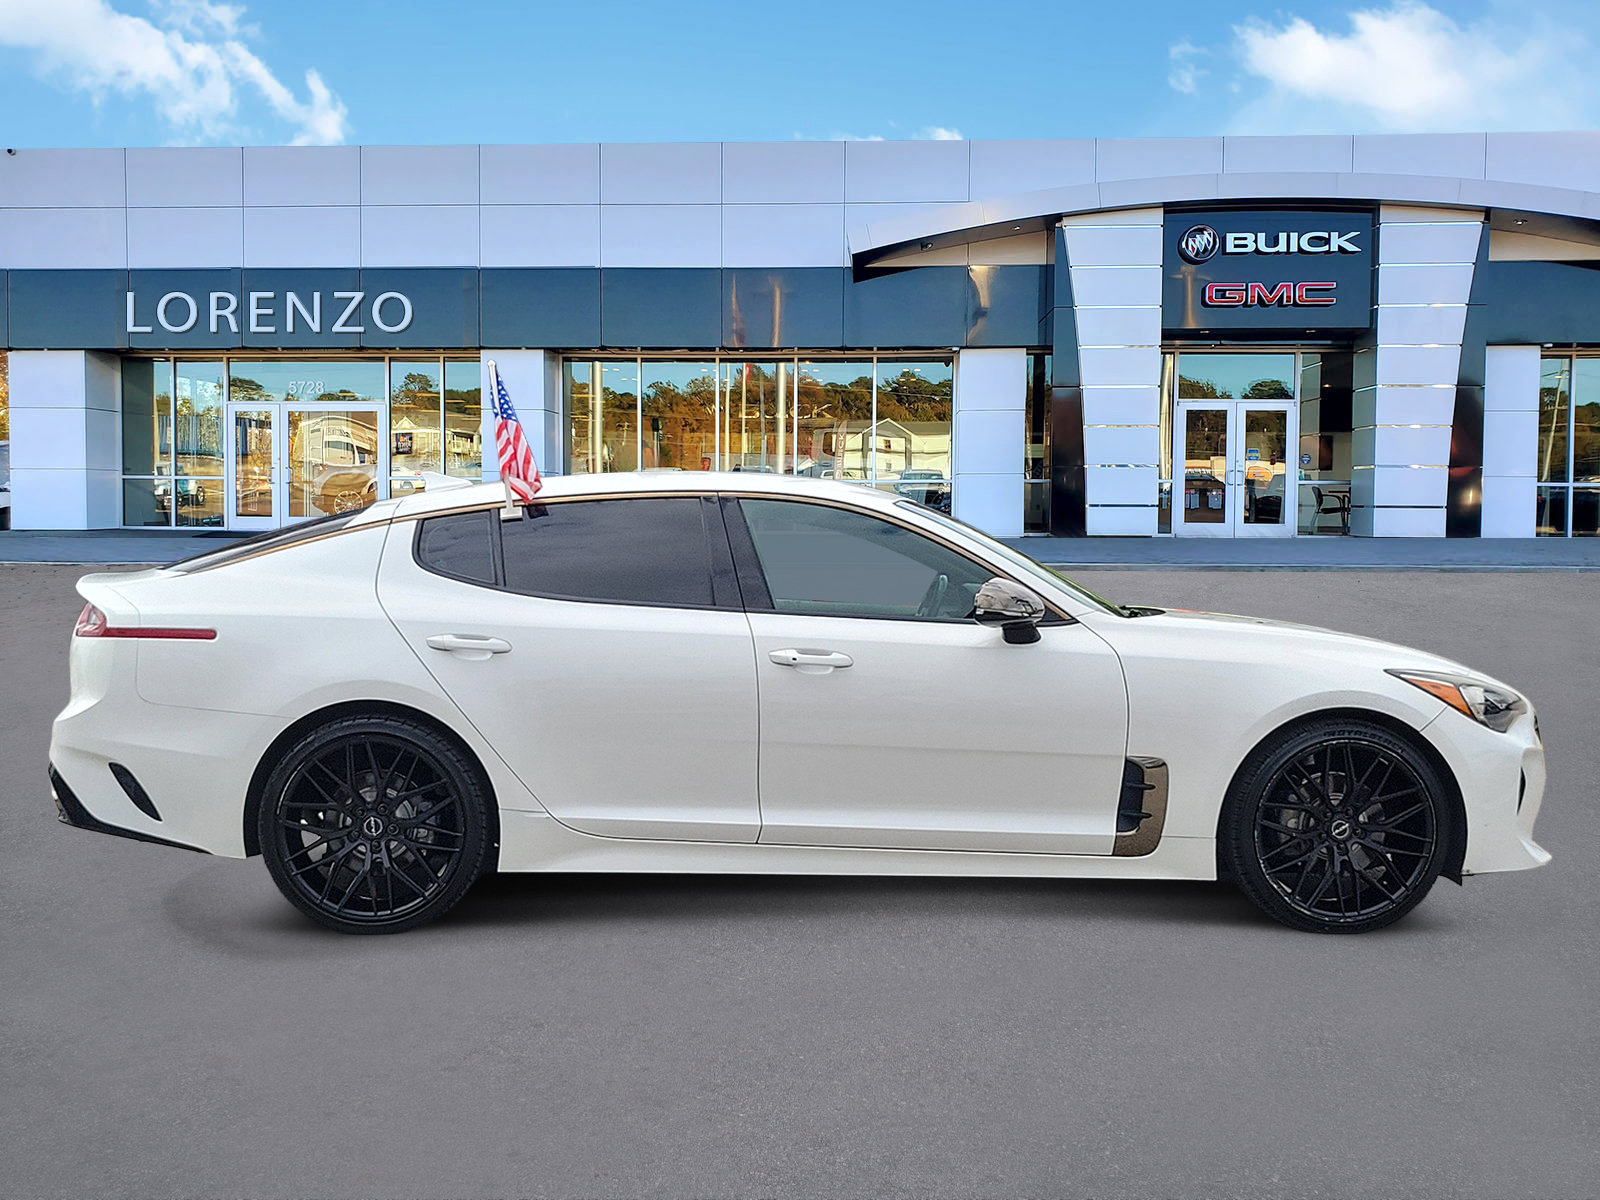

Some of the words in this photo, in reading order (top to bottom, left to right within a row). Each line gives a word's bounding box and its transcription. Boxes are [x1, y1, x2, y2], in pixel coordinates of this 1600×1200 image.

[1225, 231, 1361, 254] BUICK
[1203, 281, 1337, 307] GMC
[126, 290, 414, 334] LORENZO
[288, 380, 325, 395] 5728
